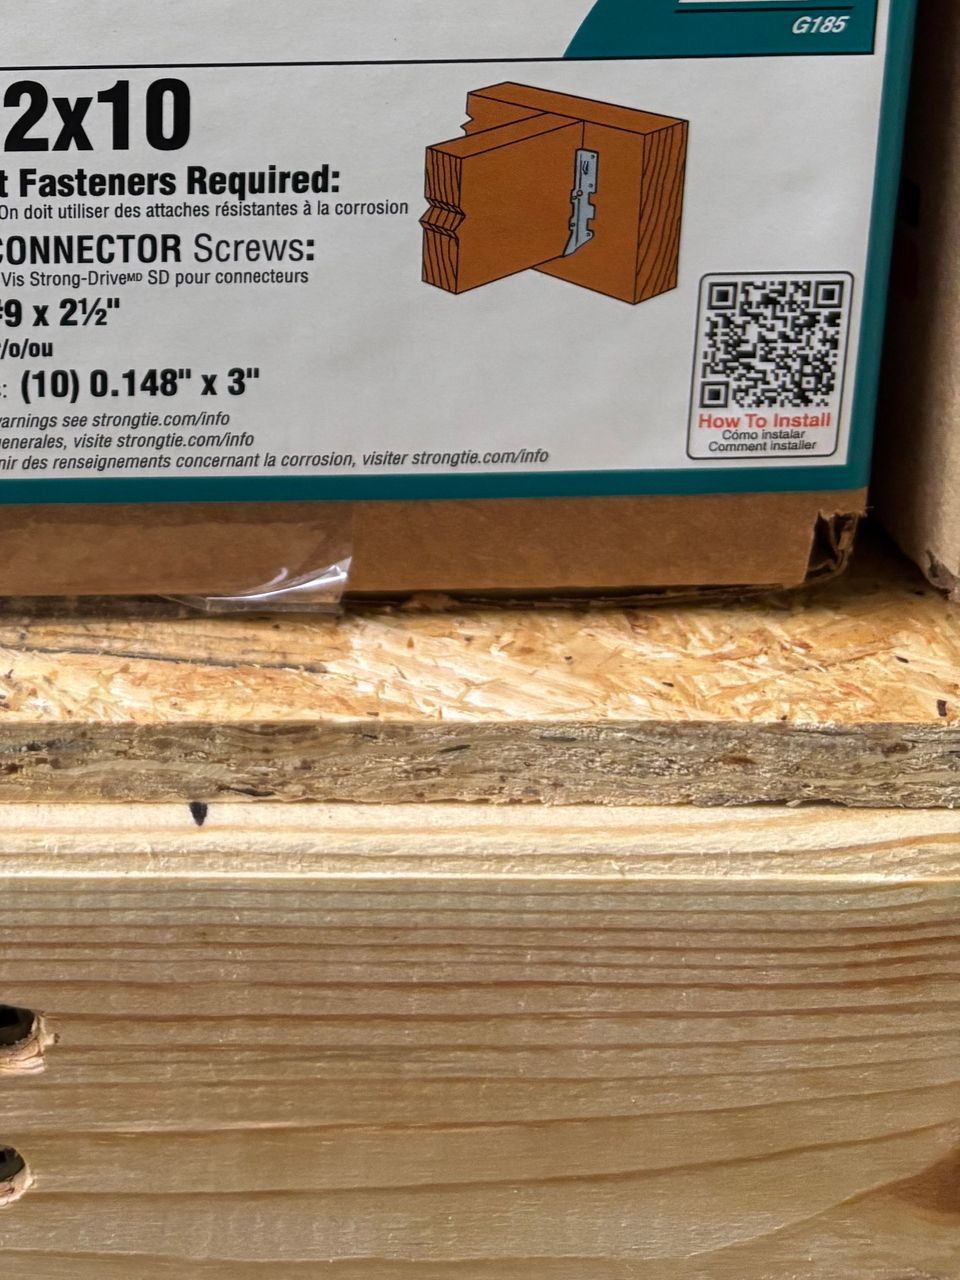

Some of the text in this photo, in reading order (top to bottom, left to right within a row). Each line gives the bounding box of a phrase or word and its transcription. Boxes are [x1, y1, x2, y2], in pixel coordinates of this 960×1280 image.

[792, 16, 849, 34] G185
[3, 78, 191, 152] 2x10
[19, 167, 176, 198] Fasteners
[187, 164, 340, 200] Required:
[24, 204, 53, 219] doit
[58, 203, 109, 220] utiliser
[115, 203, 141, 219] des
[146, 202, 209, 218] attaches
[216, 200, 297, 217] résistantes
[303, 199, 311, 216] à
[318, 200, 329, 216] la
[335, 199, 408, 216] corrosion
[194, 233, 315, 263] Screws:
[1, 272, 24, 288] Vis
[148, 269, 169, 286] SD
[176, 272, 210, 288] pour
[215, 269, 308, 284] connecteurs
[33, 305, 49, 327] x
[21, 368, 79, 404] (10)
[90, 368, 191, 398] 0.148"
[201, 374, 217, 395] x
[228, 367, 259, 396] 3"
[62, 415, 87, 428] see
[92, 411, 230, 430] strongtie.com/info
[698, 412, 831, 428] How To Install
[74, 433, 112, 448] visite
[117, 432, 254, 451] strongtie.com/info
[722, 428, 806, 440] Cómo instalar
[708, 440, 817, 452] Comment installer
[22, 455, 48, 470] des
[53, 454, 171, 472] renseignements
[176, 453, 260, 468] concernant
[264, 452, 276, 468] la
[281, 451, 356, 468] corrosion,
[363, 450, 409, 466] visiter
[412, 448, 549, 468] strongtie.com/info
